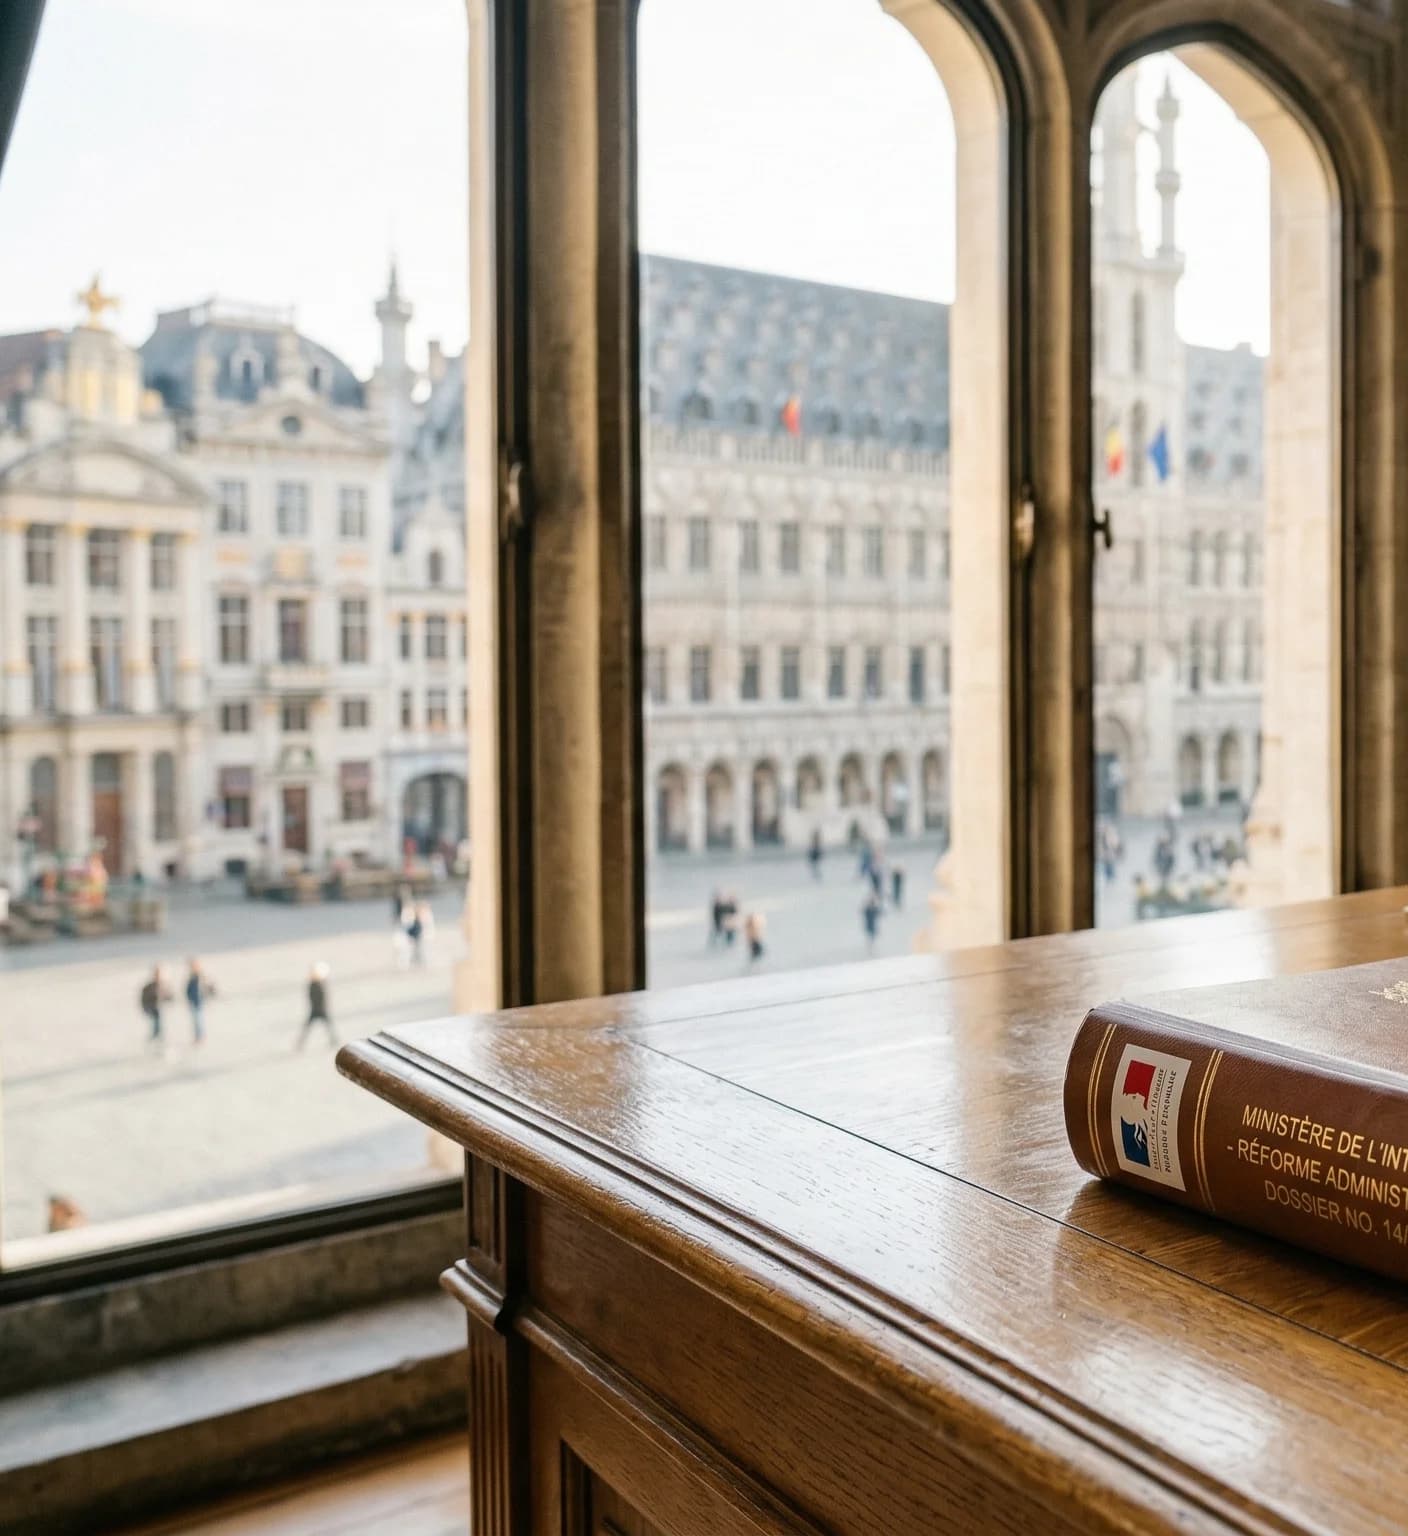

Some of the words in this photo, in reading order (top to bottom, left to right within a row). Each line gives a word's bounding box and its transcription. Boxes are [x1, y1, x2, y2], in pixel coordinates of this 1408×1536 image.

[1242, 1104, 1335, 1150] MINISTÈRE
[1337, 1131, 1364, 1159] DE
[1238, 1137, 1321, 1183] RÉFORME
[1264, 1179, 1343, 1225] DOSSIER
[1345, 1207, 1378, 1236] NO.
